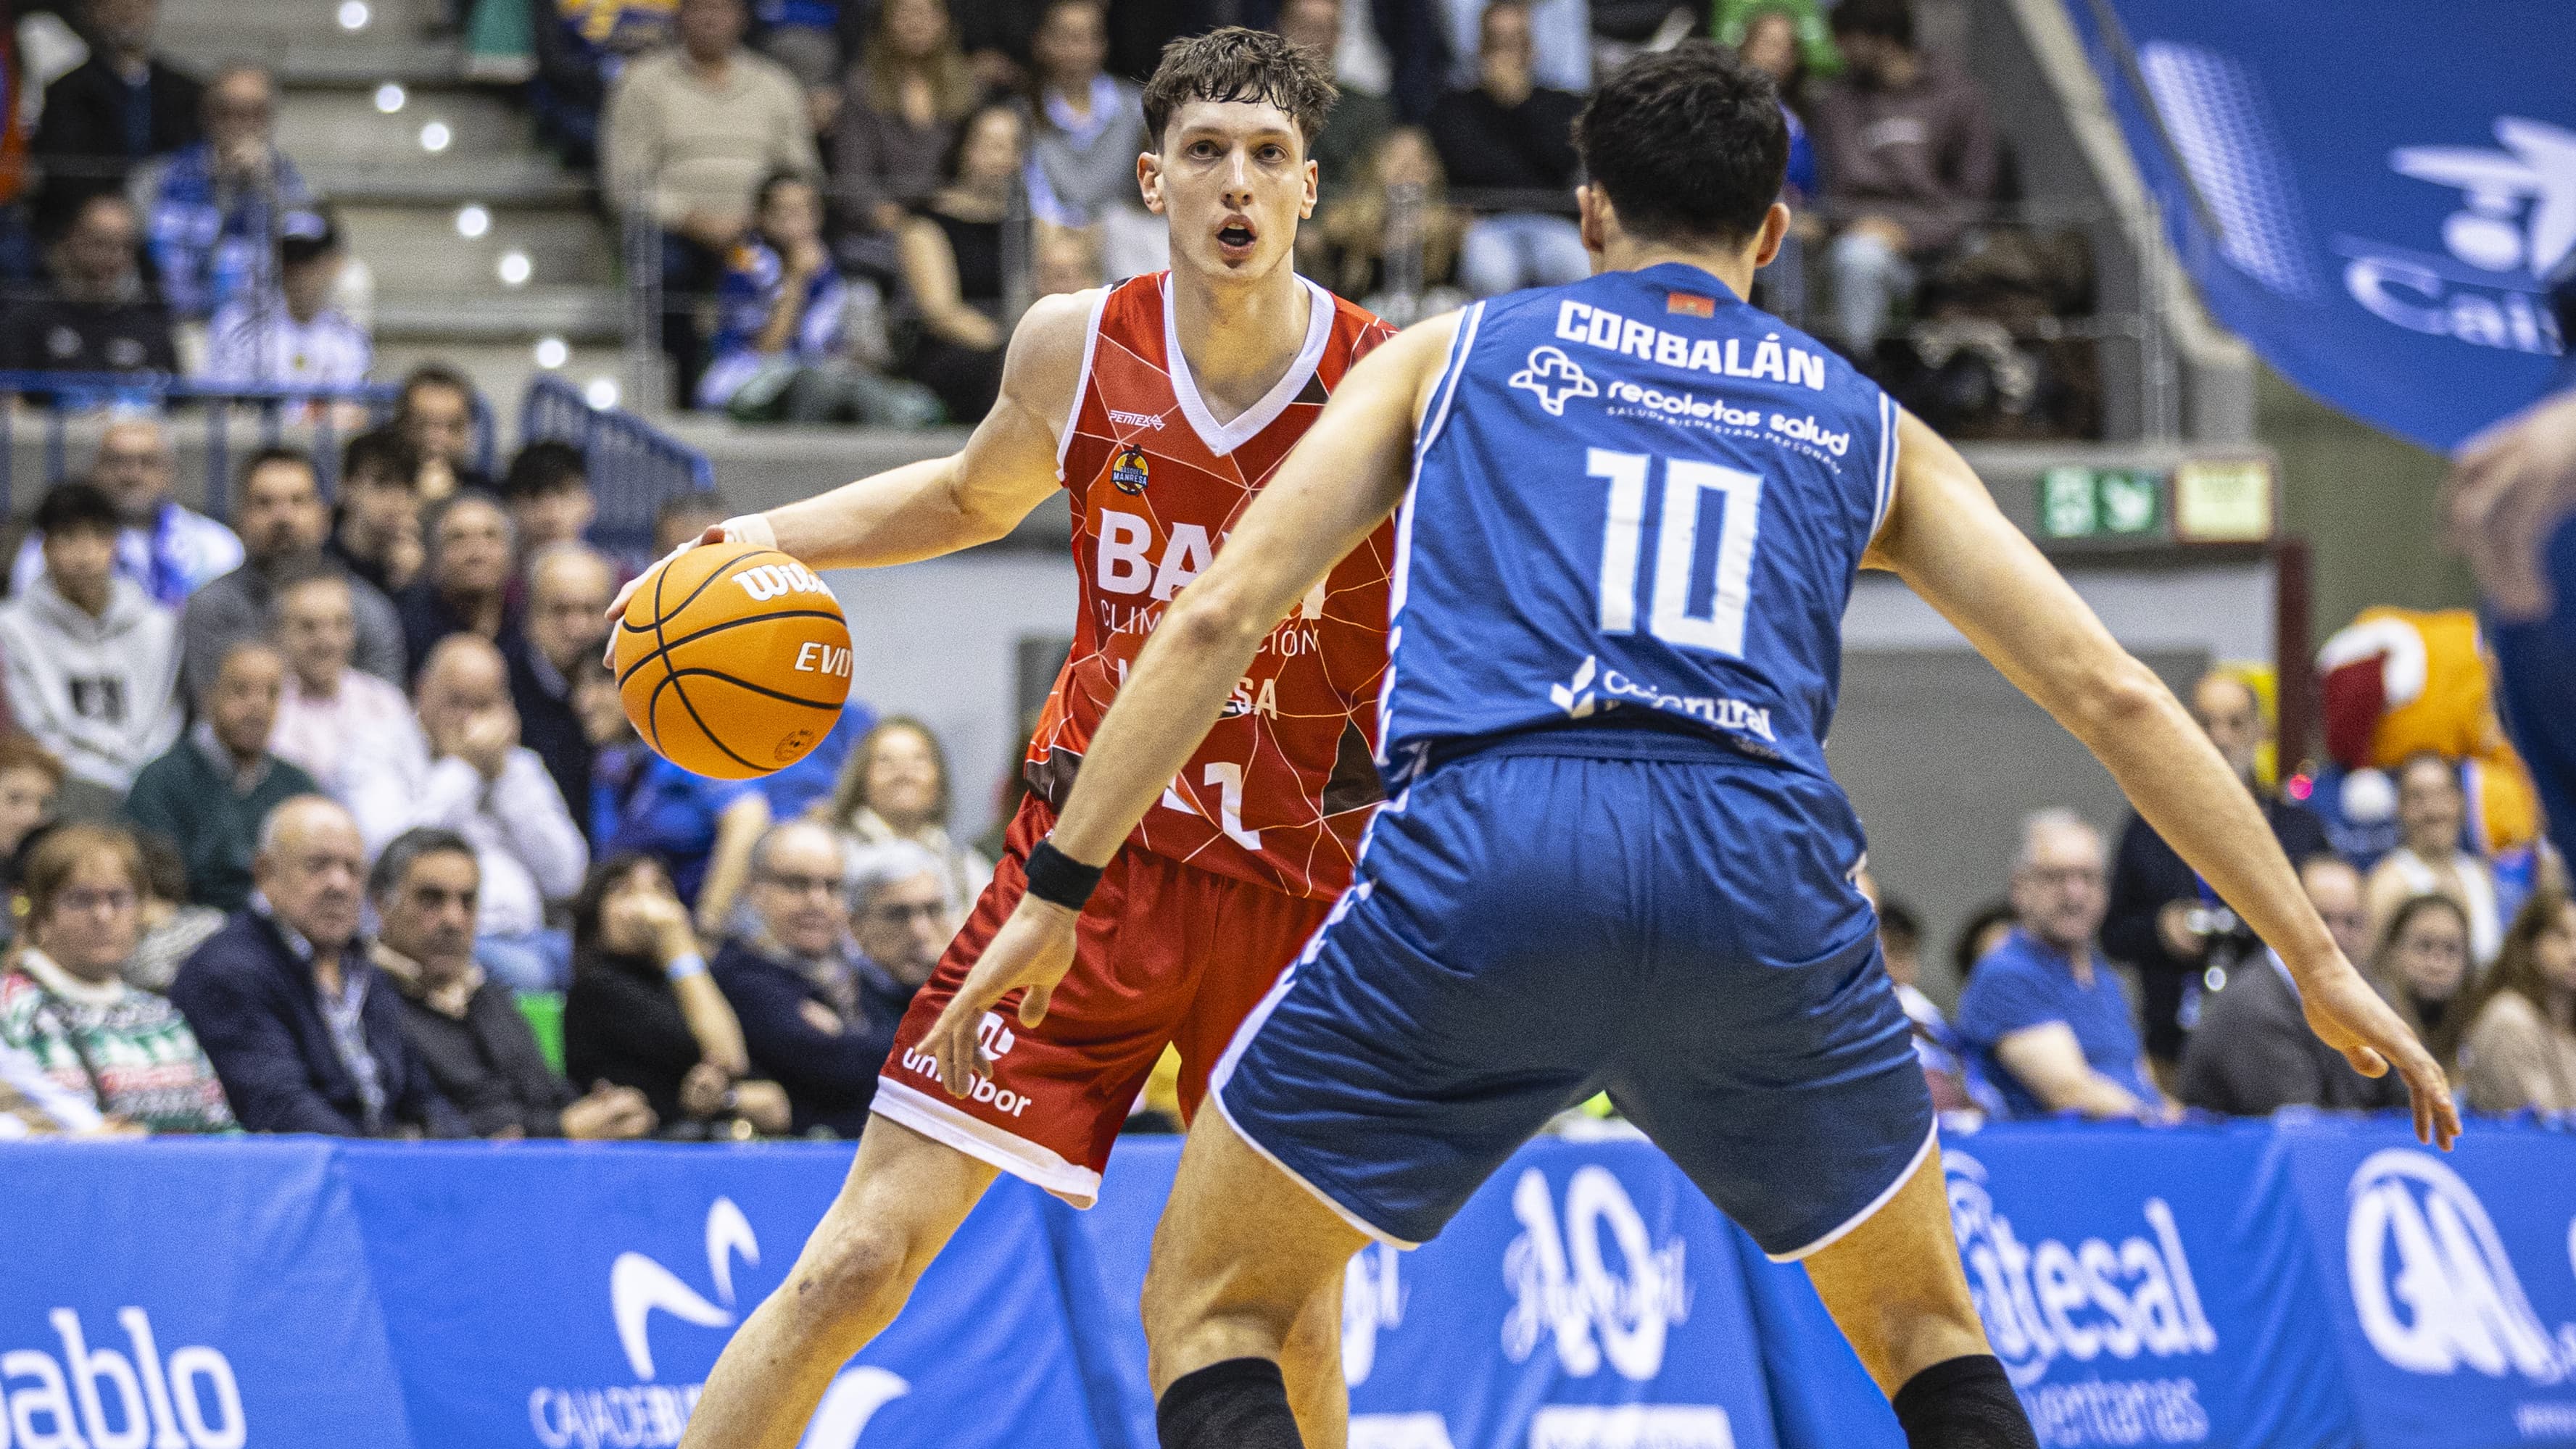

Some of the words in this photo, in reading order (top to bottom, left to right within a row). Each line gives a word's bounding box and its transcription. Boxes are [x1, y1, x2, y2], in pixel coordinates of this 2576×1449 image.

[1555, 299, 1825, 391] CORBALÁN
[2345, 258, 2564, 356] Cai
[1109, 410, 1151, 428] PENTEX
[1607, 380, 1761, 427] recoletas
[1769, 415, 1850, 457] salud
[1112, 471, 1148, 486] MANRESA
[1586, 446, 1765, 660] 10
[1101, 599, 1319, 657] CLIMIÓN
[902, 1047, 1032, 1118] unbor
[0, 1305, 248, 1449] ablo
